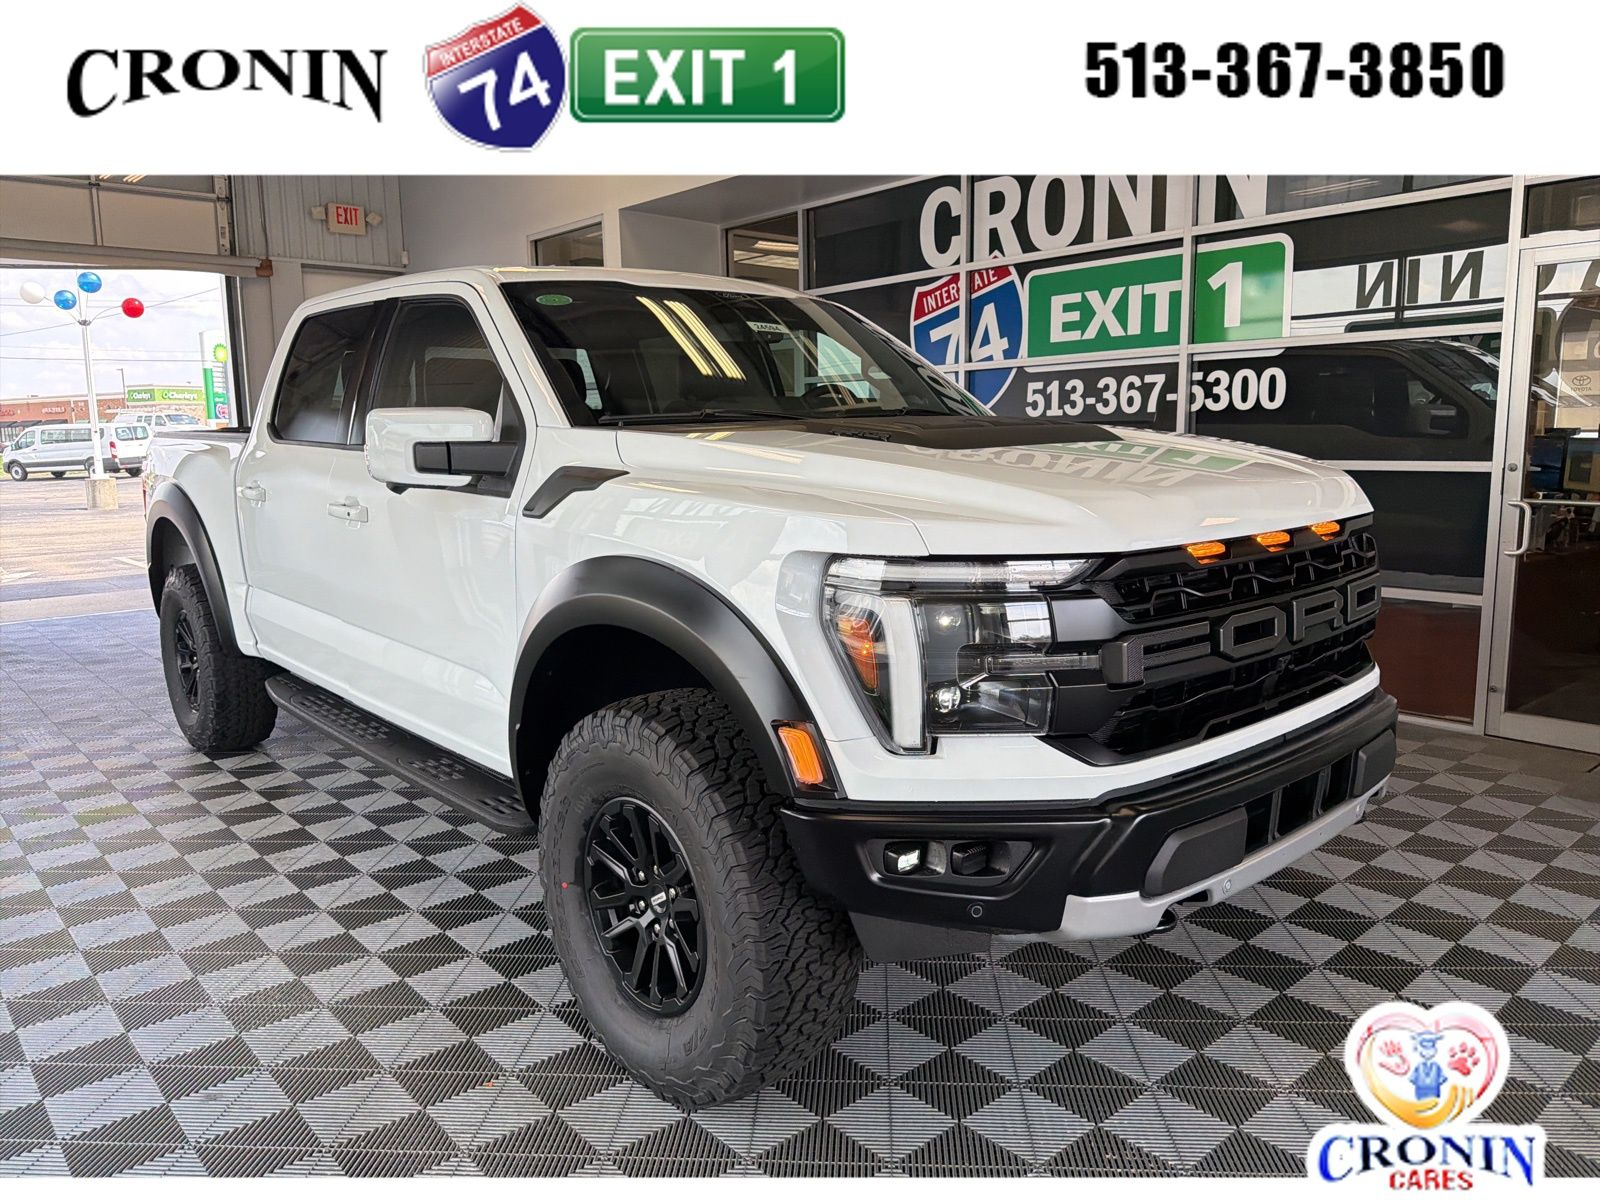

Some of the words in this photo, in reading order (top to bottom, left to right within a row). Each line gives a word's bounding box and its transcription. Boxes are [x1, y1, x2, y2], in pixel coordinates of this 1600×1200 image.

[335, 206, 359, 225] EXIT
[919, 174, 1267, 269] CRONIN
[929, 302, 1010, 384] 74
[1050, 280, 1182, 343] EXIT
[1207, 262, 1243, 328] 1
[1025, 367, 1287, 417] 513-367-5300
[1102, 573, 1381, 684] FORD
